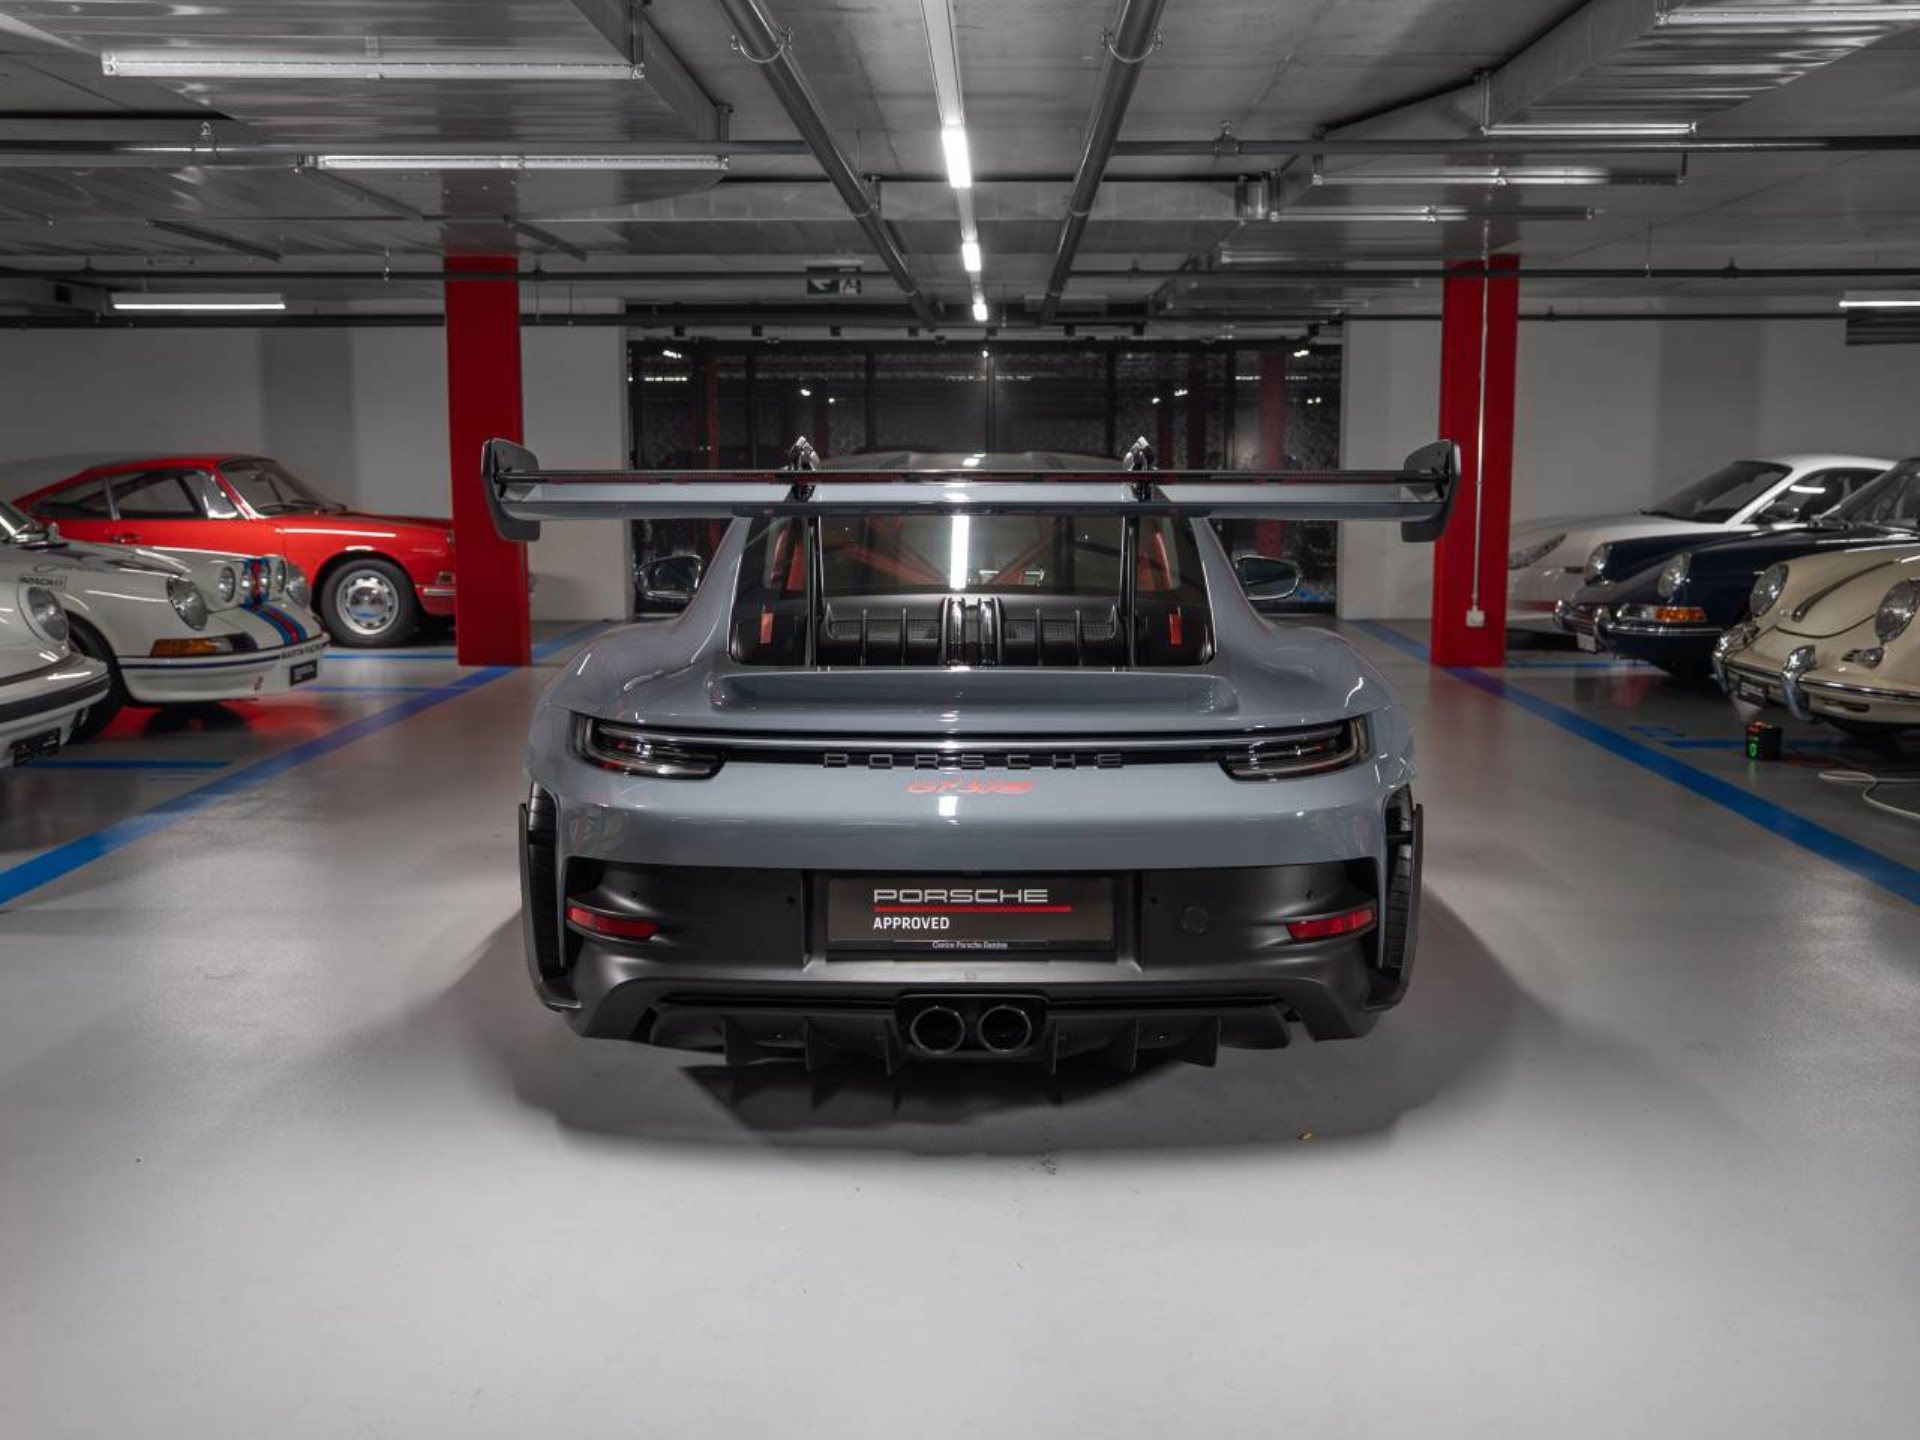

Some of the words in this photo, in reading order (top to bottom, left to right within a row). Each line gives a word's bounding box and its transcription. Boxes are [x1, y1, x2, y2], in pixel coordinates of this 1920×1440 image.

[823, 753, 1123, 769] PORSCHE
[873, 888, 1049, 903] PORSCHE
[873, 916, 950, 930] APPROVED
